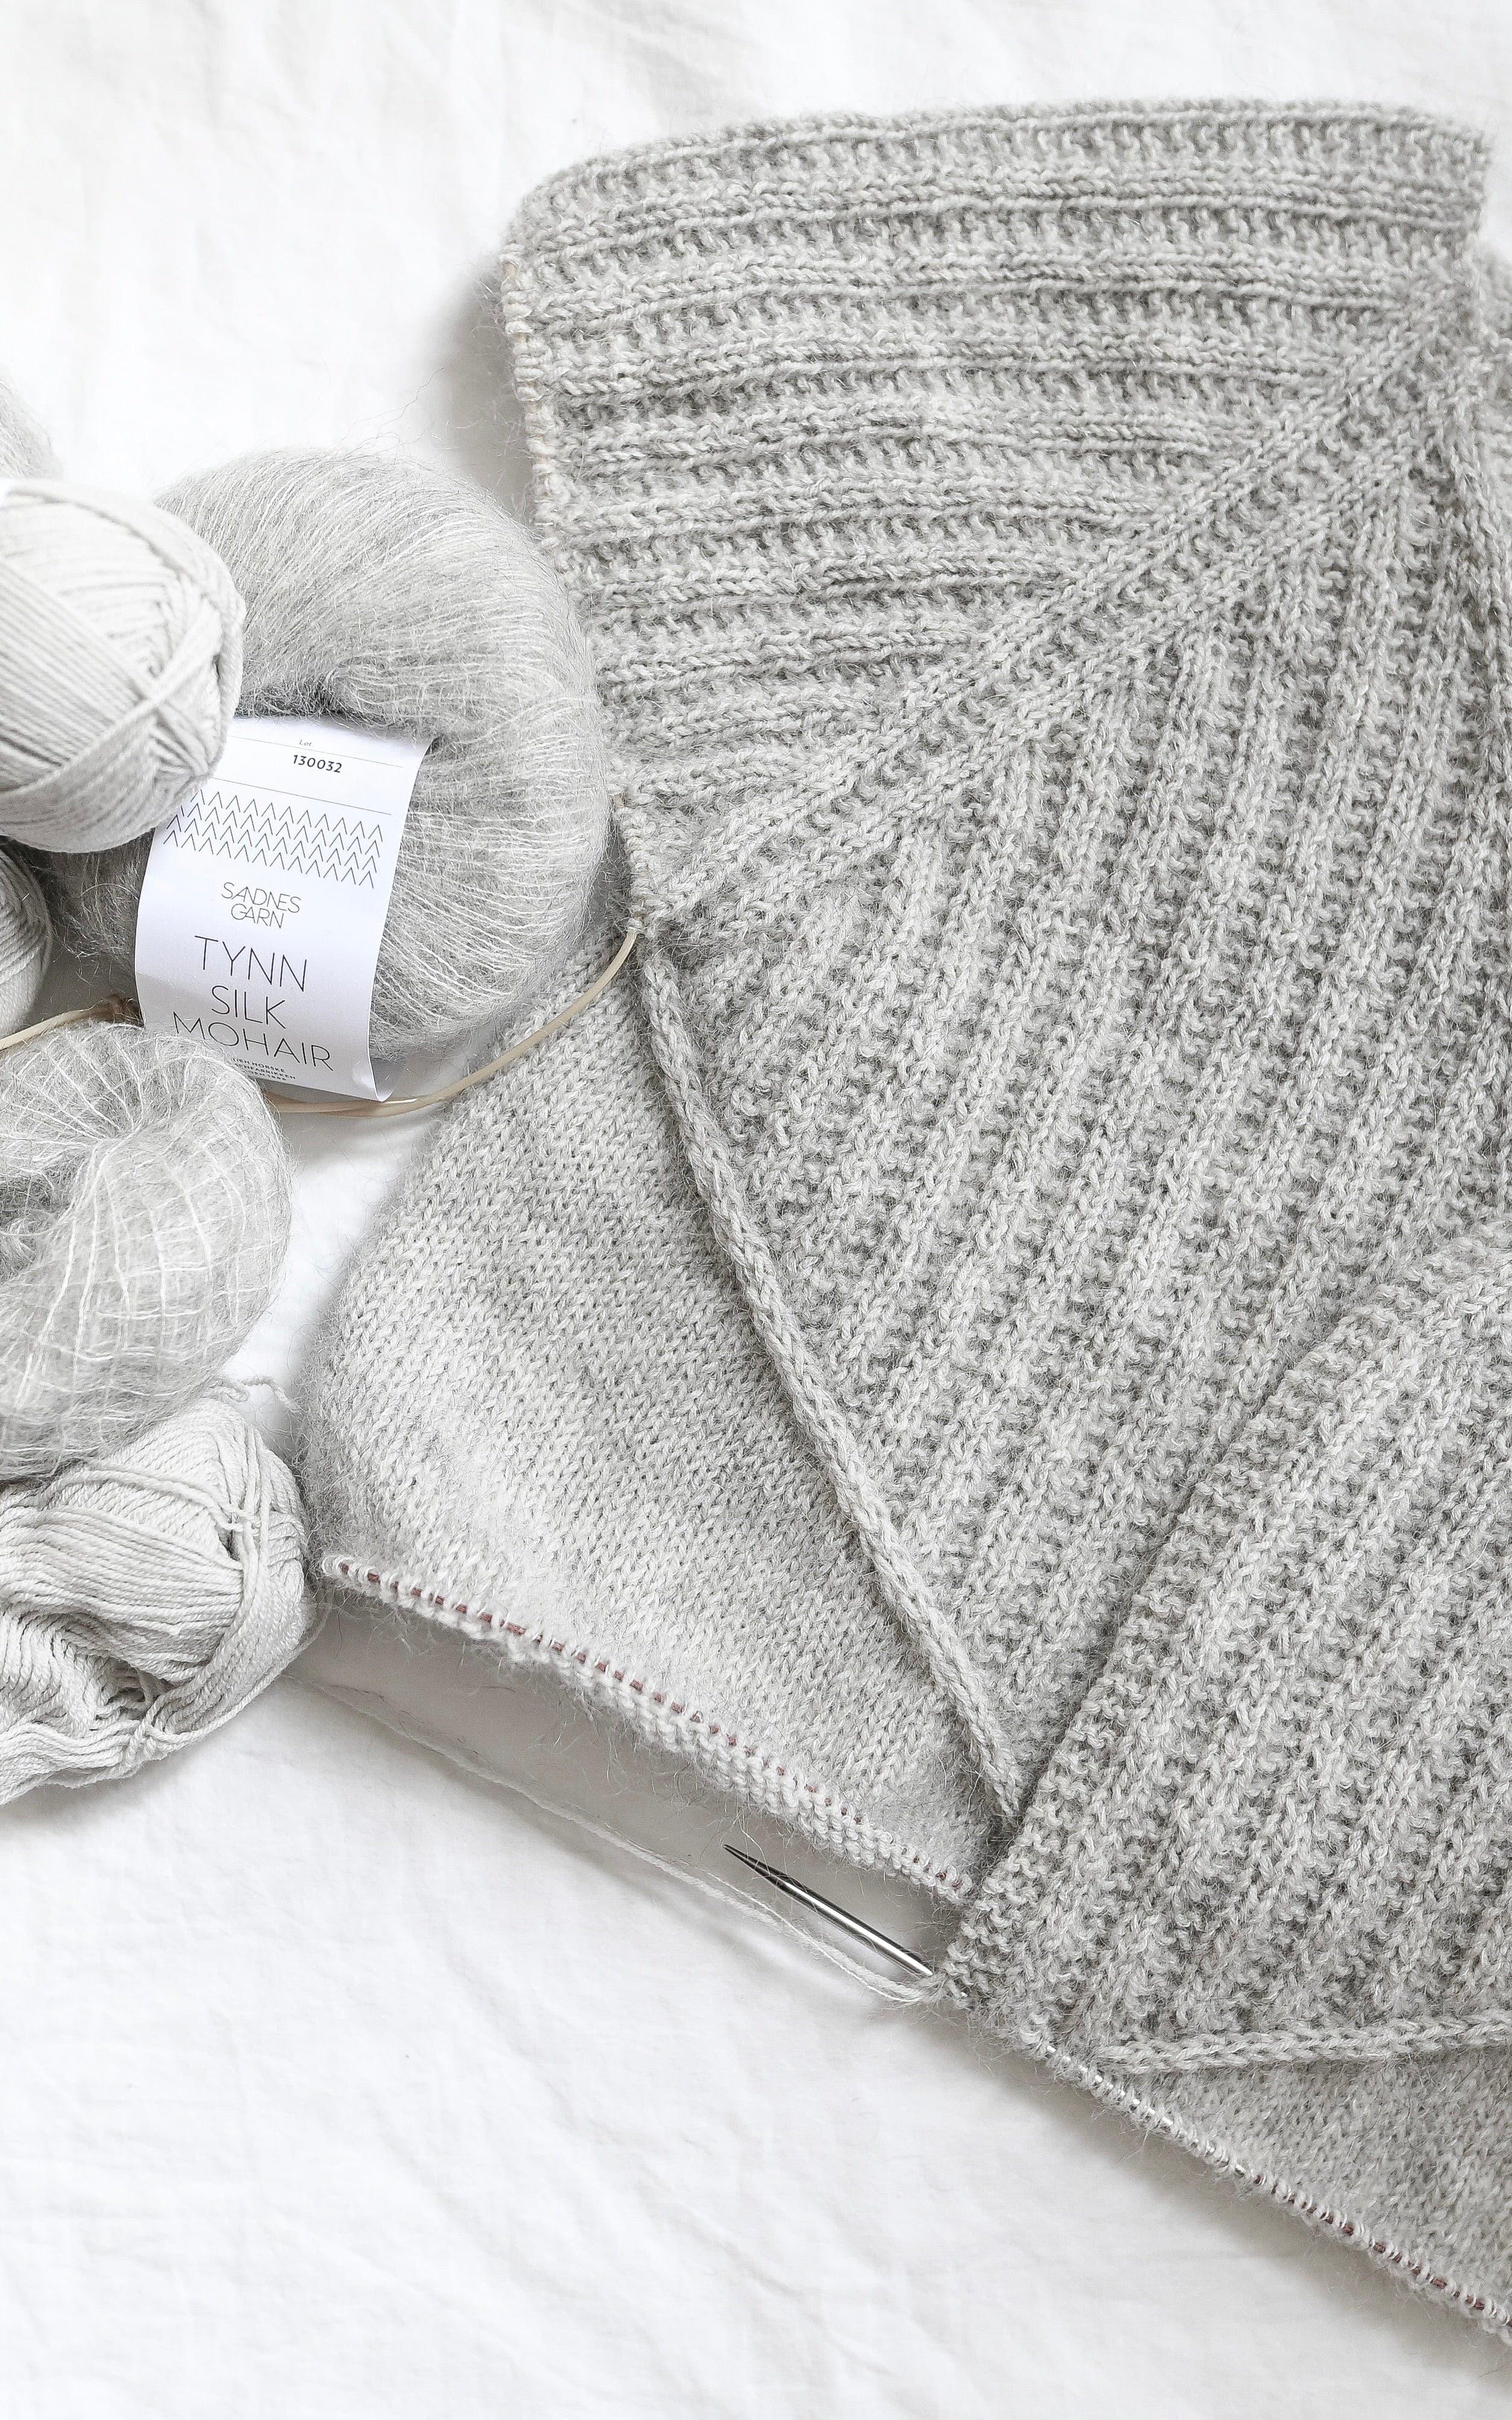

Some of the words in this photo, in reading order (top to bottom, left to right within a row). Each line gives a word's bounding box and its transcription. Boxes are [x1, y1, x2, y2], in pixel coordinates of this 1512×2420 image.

[293, 754, 342, 773] 130032
[221, 882, 301, 914] SANDNES
[231, 903, 284, 929] GARN
[194, 935, 307, 992] TYNN
[211, 985, 287, 1029] SILK
[173, 1011, 334, 1071] MOHAIR
